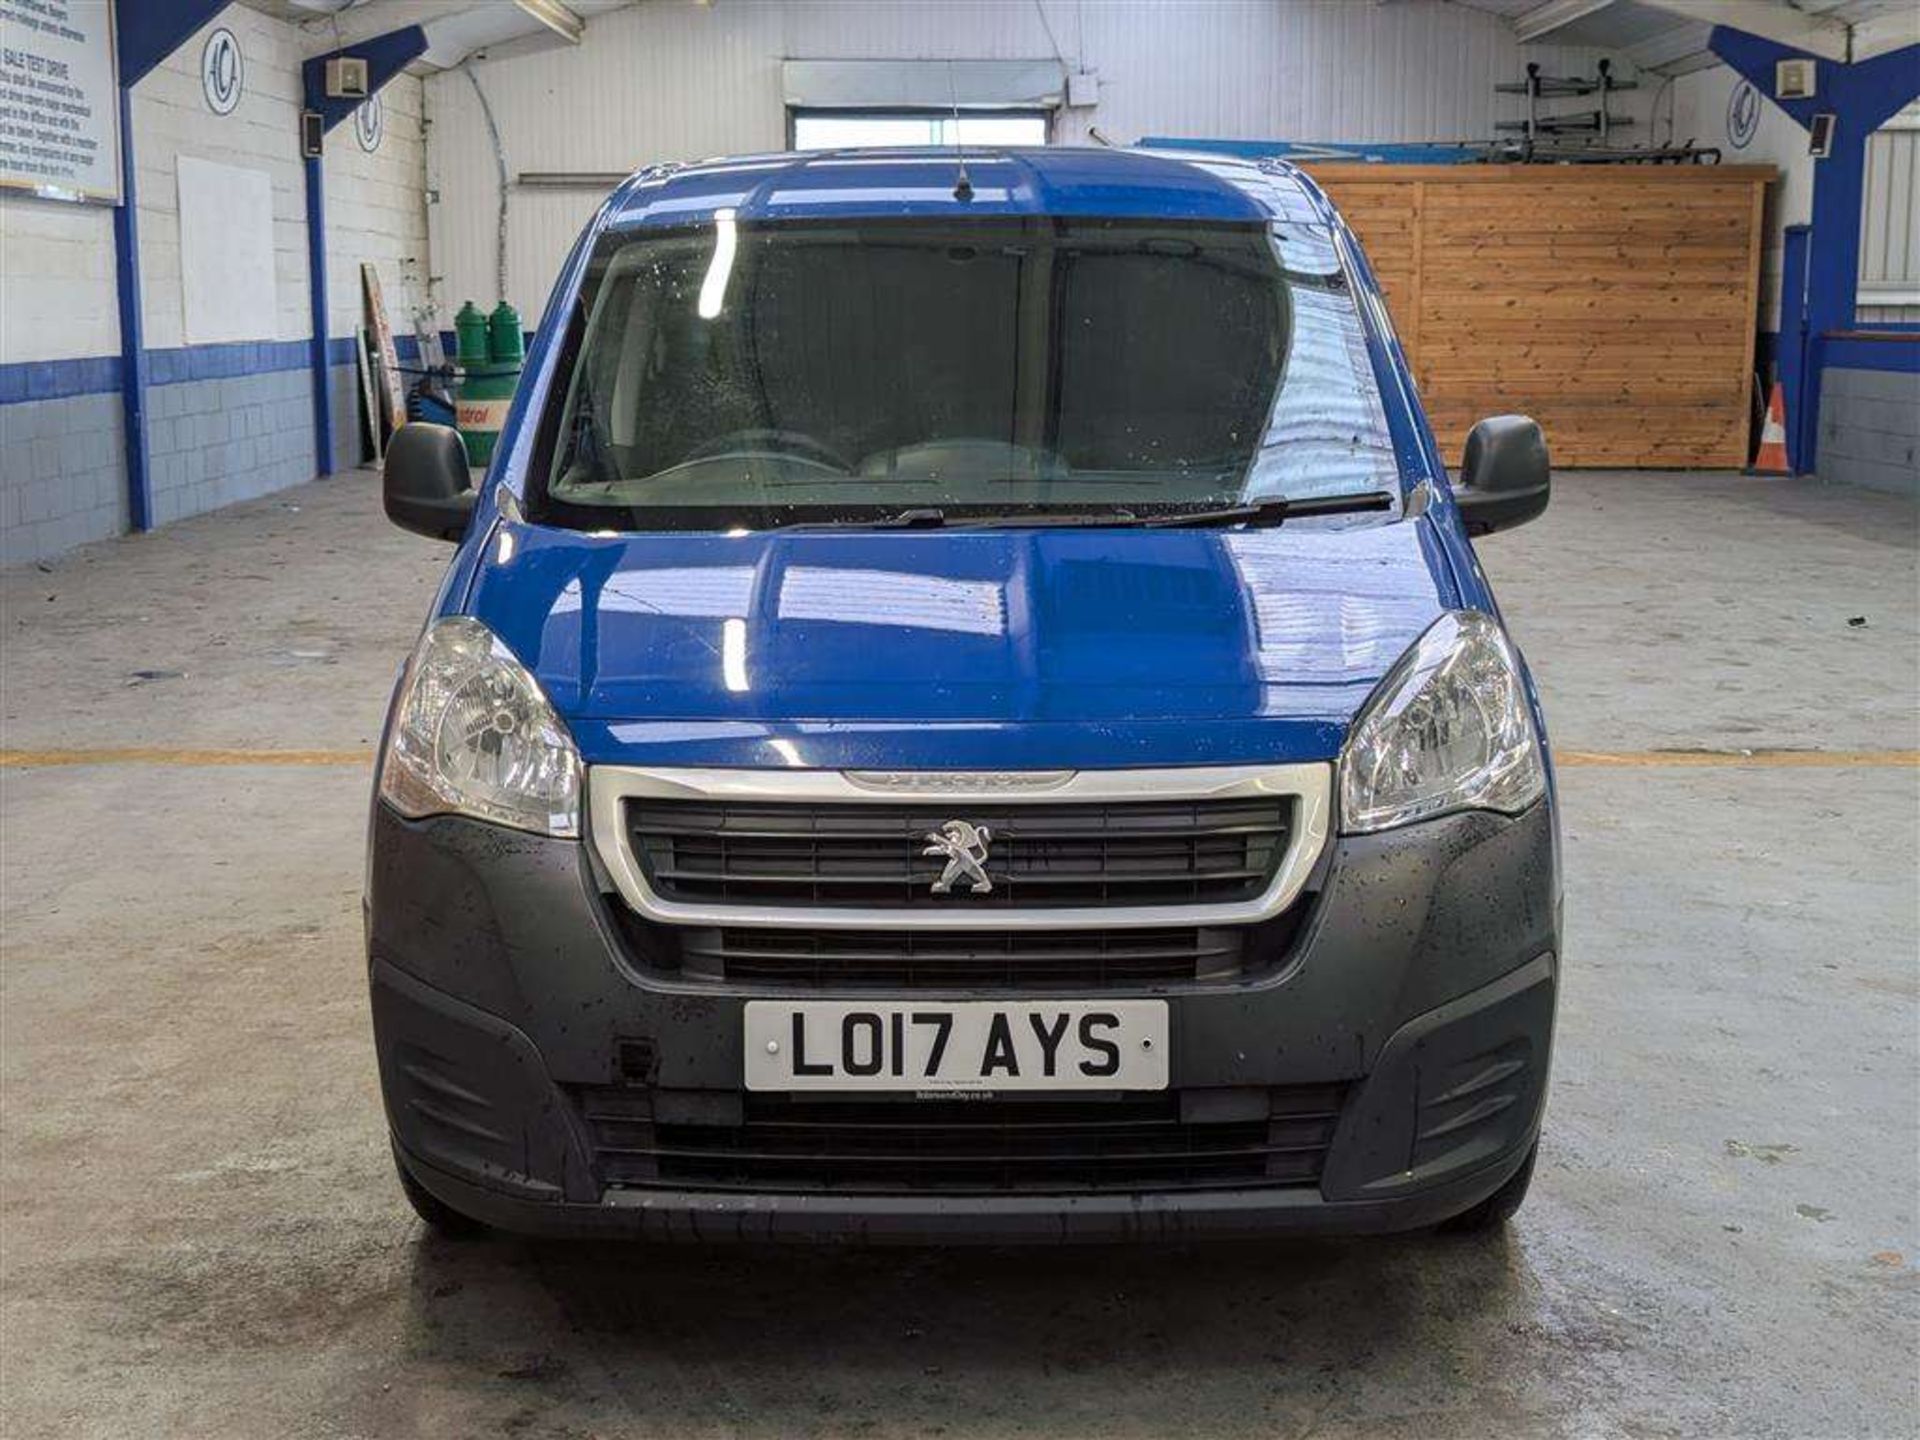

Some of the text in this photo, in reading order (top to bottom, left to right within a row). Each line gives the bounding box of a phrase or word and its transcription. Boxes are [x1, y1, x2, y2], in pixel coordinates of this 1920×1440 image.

[4, 48, 24, 67] SALE
[26, 53, 45, 72] TEST
[792, 1012, 1121, 1077] LO17 AYS
